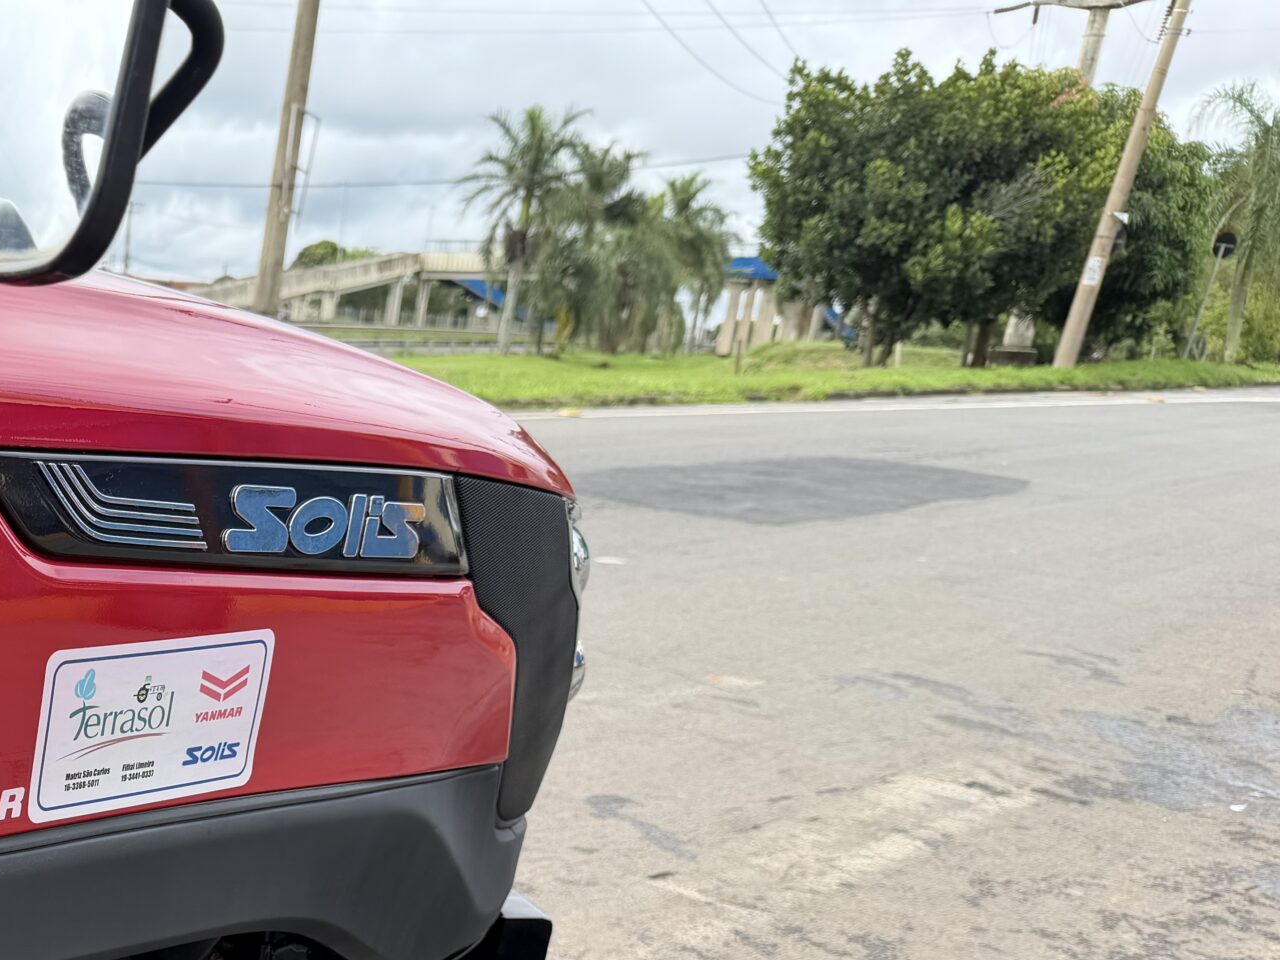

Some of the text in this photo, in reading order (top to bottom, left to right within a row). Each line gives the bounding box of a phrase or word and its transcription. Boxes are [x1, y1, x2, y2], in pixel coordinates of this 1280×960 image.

[195, 706, 244, 724] YANMAR
[122, 760, 155, 772] Filial Limeira
[65, 767, 111, 781] Matriz São Carlos
